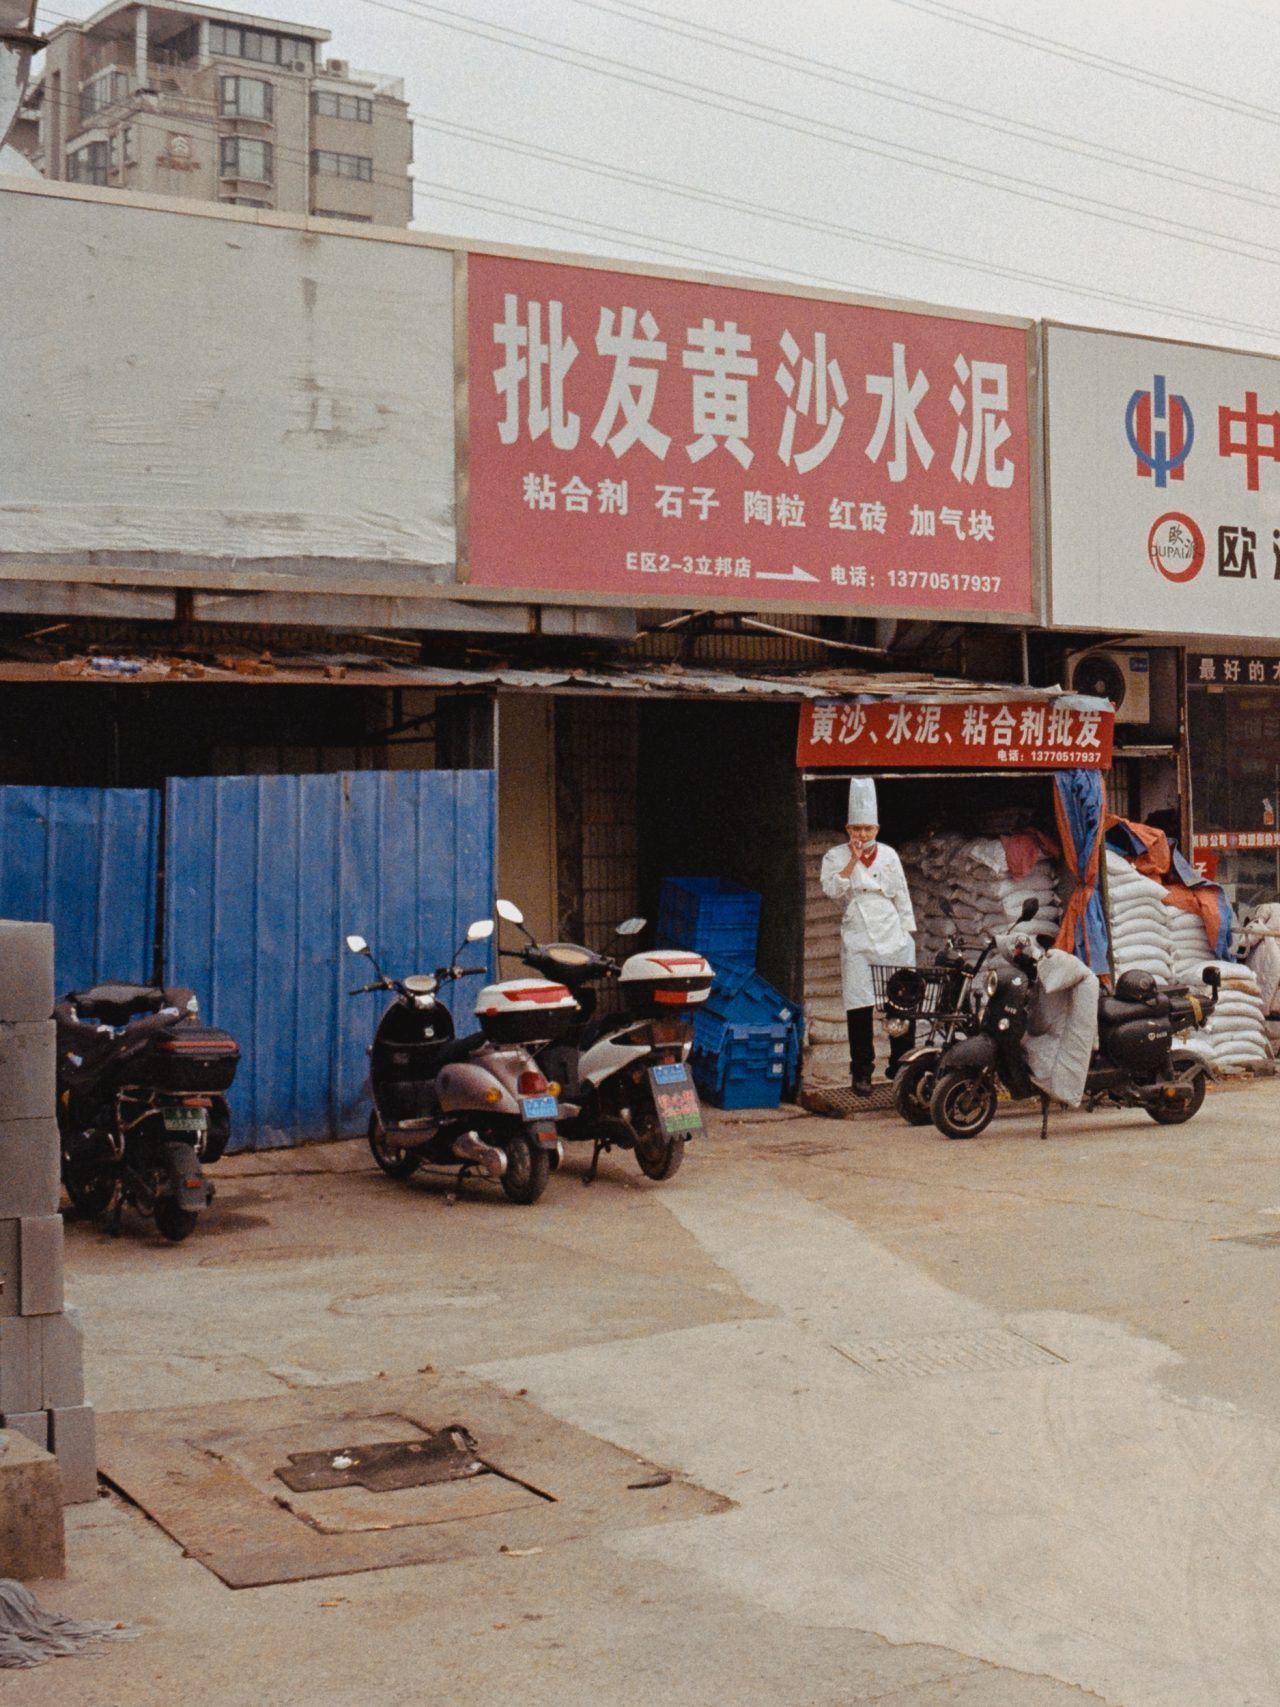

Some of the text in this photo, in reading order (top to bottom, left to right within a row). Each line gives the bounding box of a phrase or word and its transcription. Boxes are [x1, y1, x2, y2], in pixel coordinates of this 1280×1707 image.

[493, 293, 1015, 489] 批发黄沙水泥
[523, 474, 995, 542] 粘合剂 石子 陶粒 红砖 加气块
[626, 552, 751, 579] E区2-3立邦店
[810, 703, 1101, 748] 黄沙、水泥、粘合剂批发
